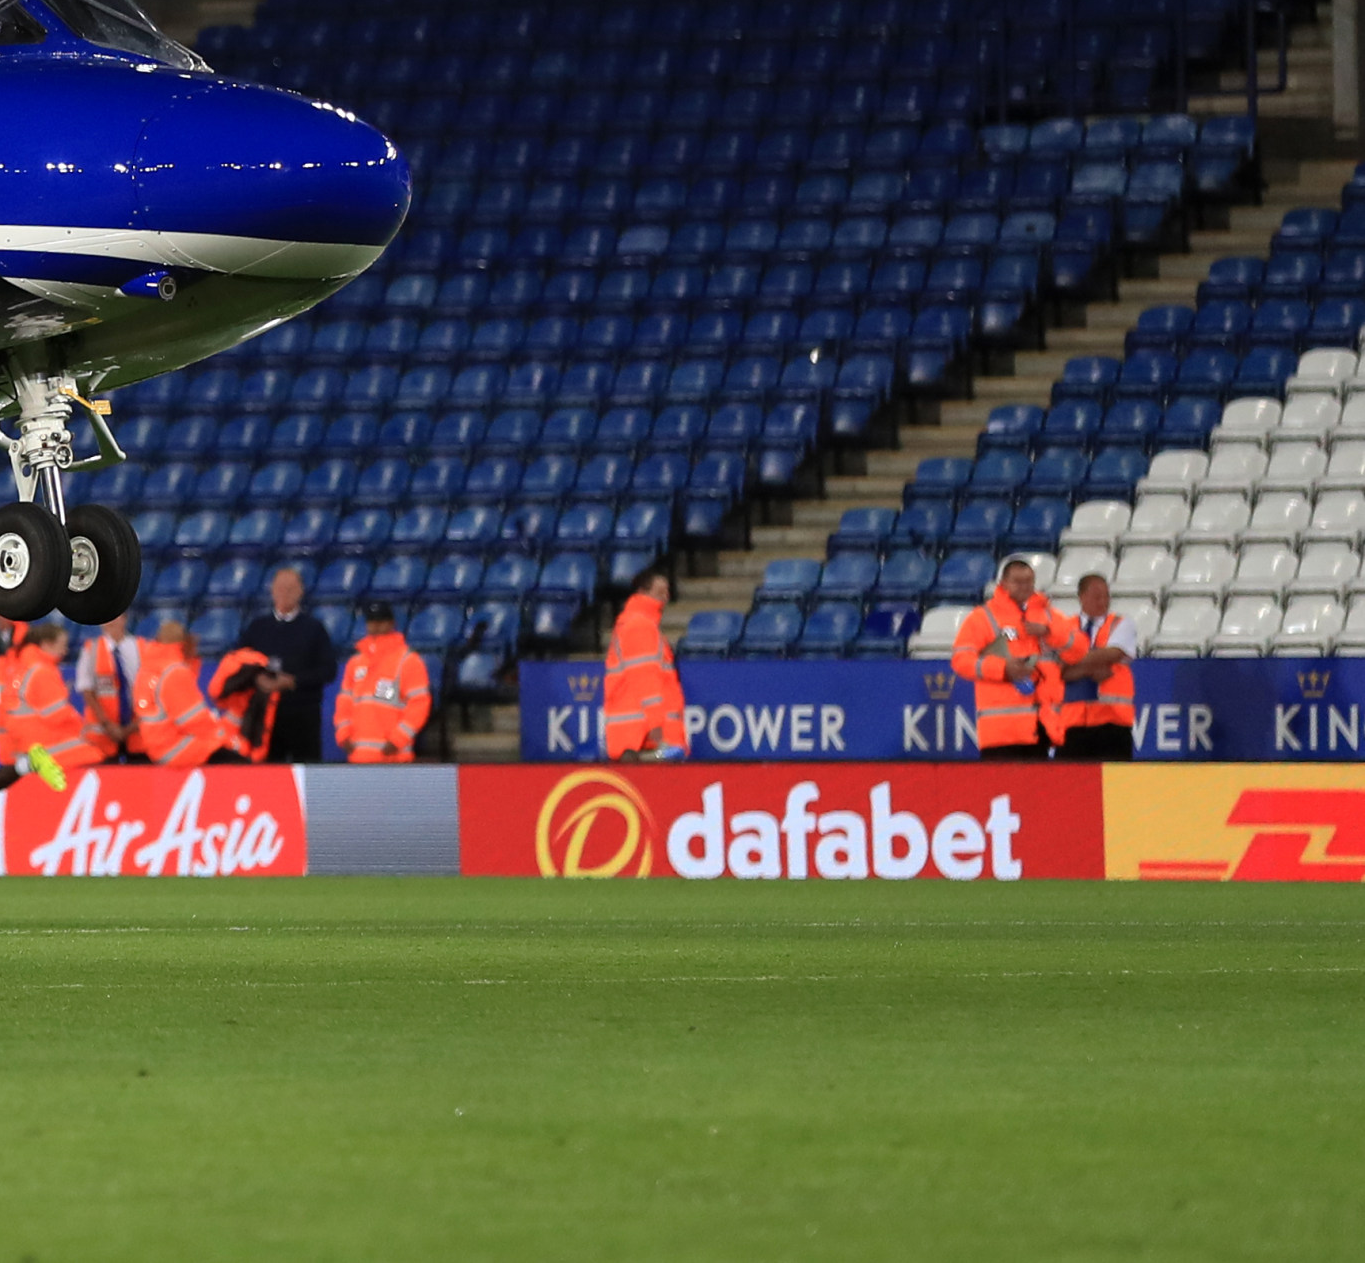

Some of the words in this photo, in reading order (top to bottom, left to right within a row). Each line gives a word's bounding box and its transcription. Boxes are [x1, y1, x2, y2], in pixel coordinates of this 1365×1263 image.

[684, 704, 846, 752] POWER
[903, 704, 979, 752] KIN
[1274, 704, 1364, 752] KIN
[666, 780, 1023, 882] dafabet
